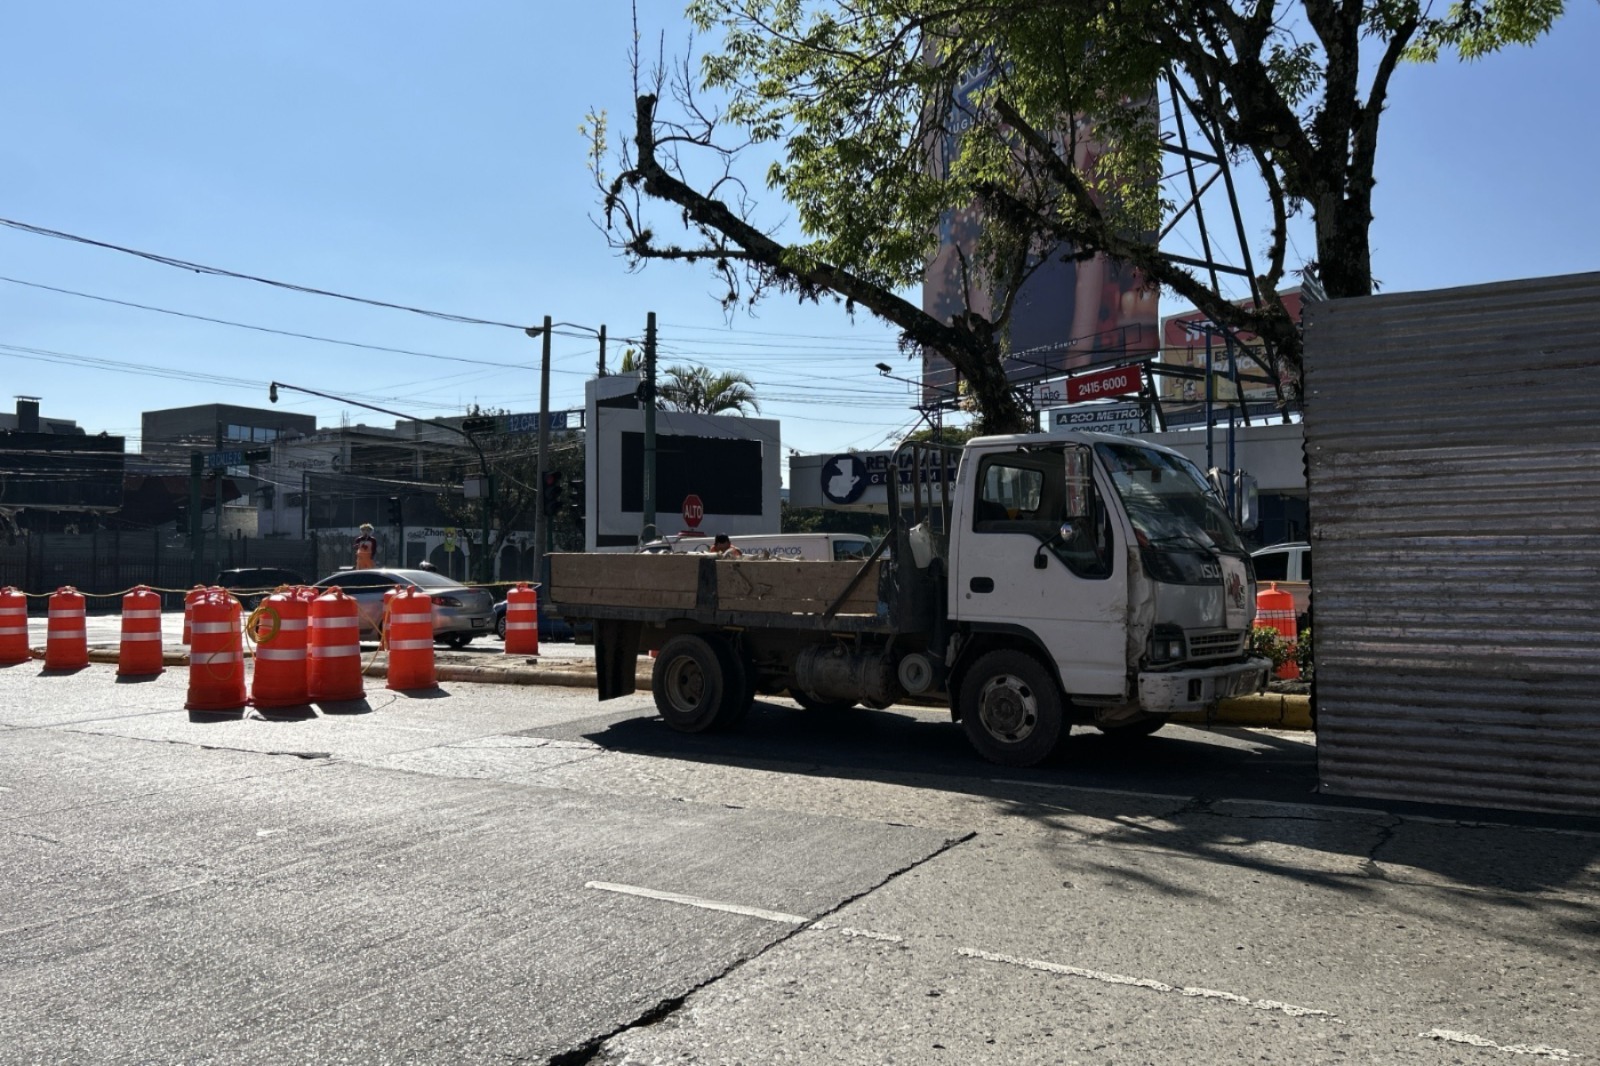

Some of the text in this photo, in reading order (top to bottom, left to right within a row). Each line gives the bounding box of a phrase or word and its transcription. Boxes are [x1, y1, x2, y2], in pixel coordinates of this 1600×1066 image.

[1078, 375, 1127, 396] 2415-6000
[1060, 408, 1145, 423] A 200 METROS
[509, 416, 519, 432] 12
[684, 504, 702, 519] ALTO
[424, 528, 444, 537] Zhon
[1200, 564, 1220, 579] ISU
